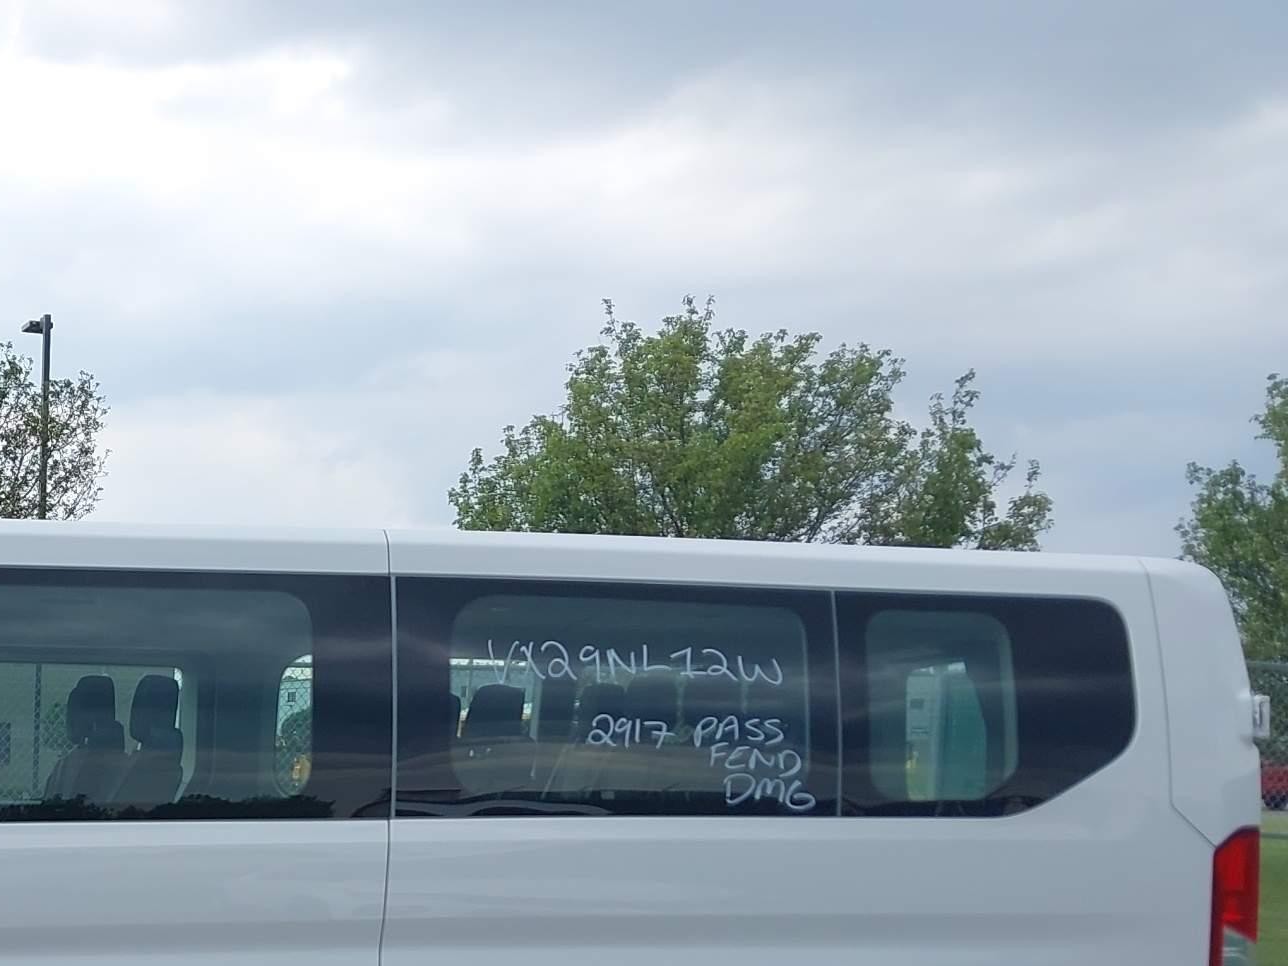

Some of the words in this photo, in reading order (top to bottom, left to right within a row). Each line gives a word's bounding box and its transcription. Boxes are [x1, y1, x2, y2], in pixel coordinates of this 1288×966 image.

[586, 713, 676, 749] 2917
[693, 714, 785, 747] PASS
[710, 741, 802, 777] FEND
[723, 773, 816, 810] DMG
